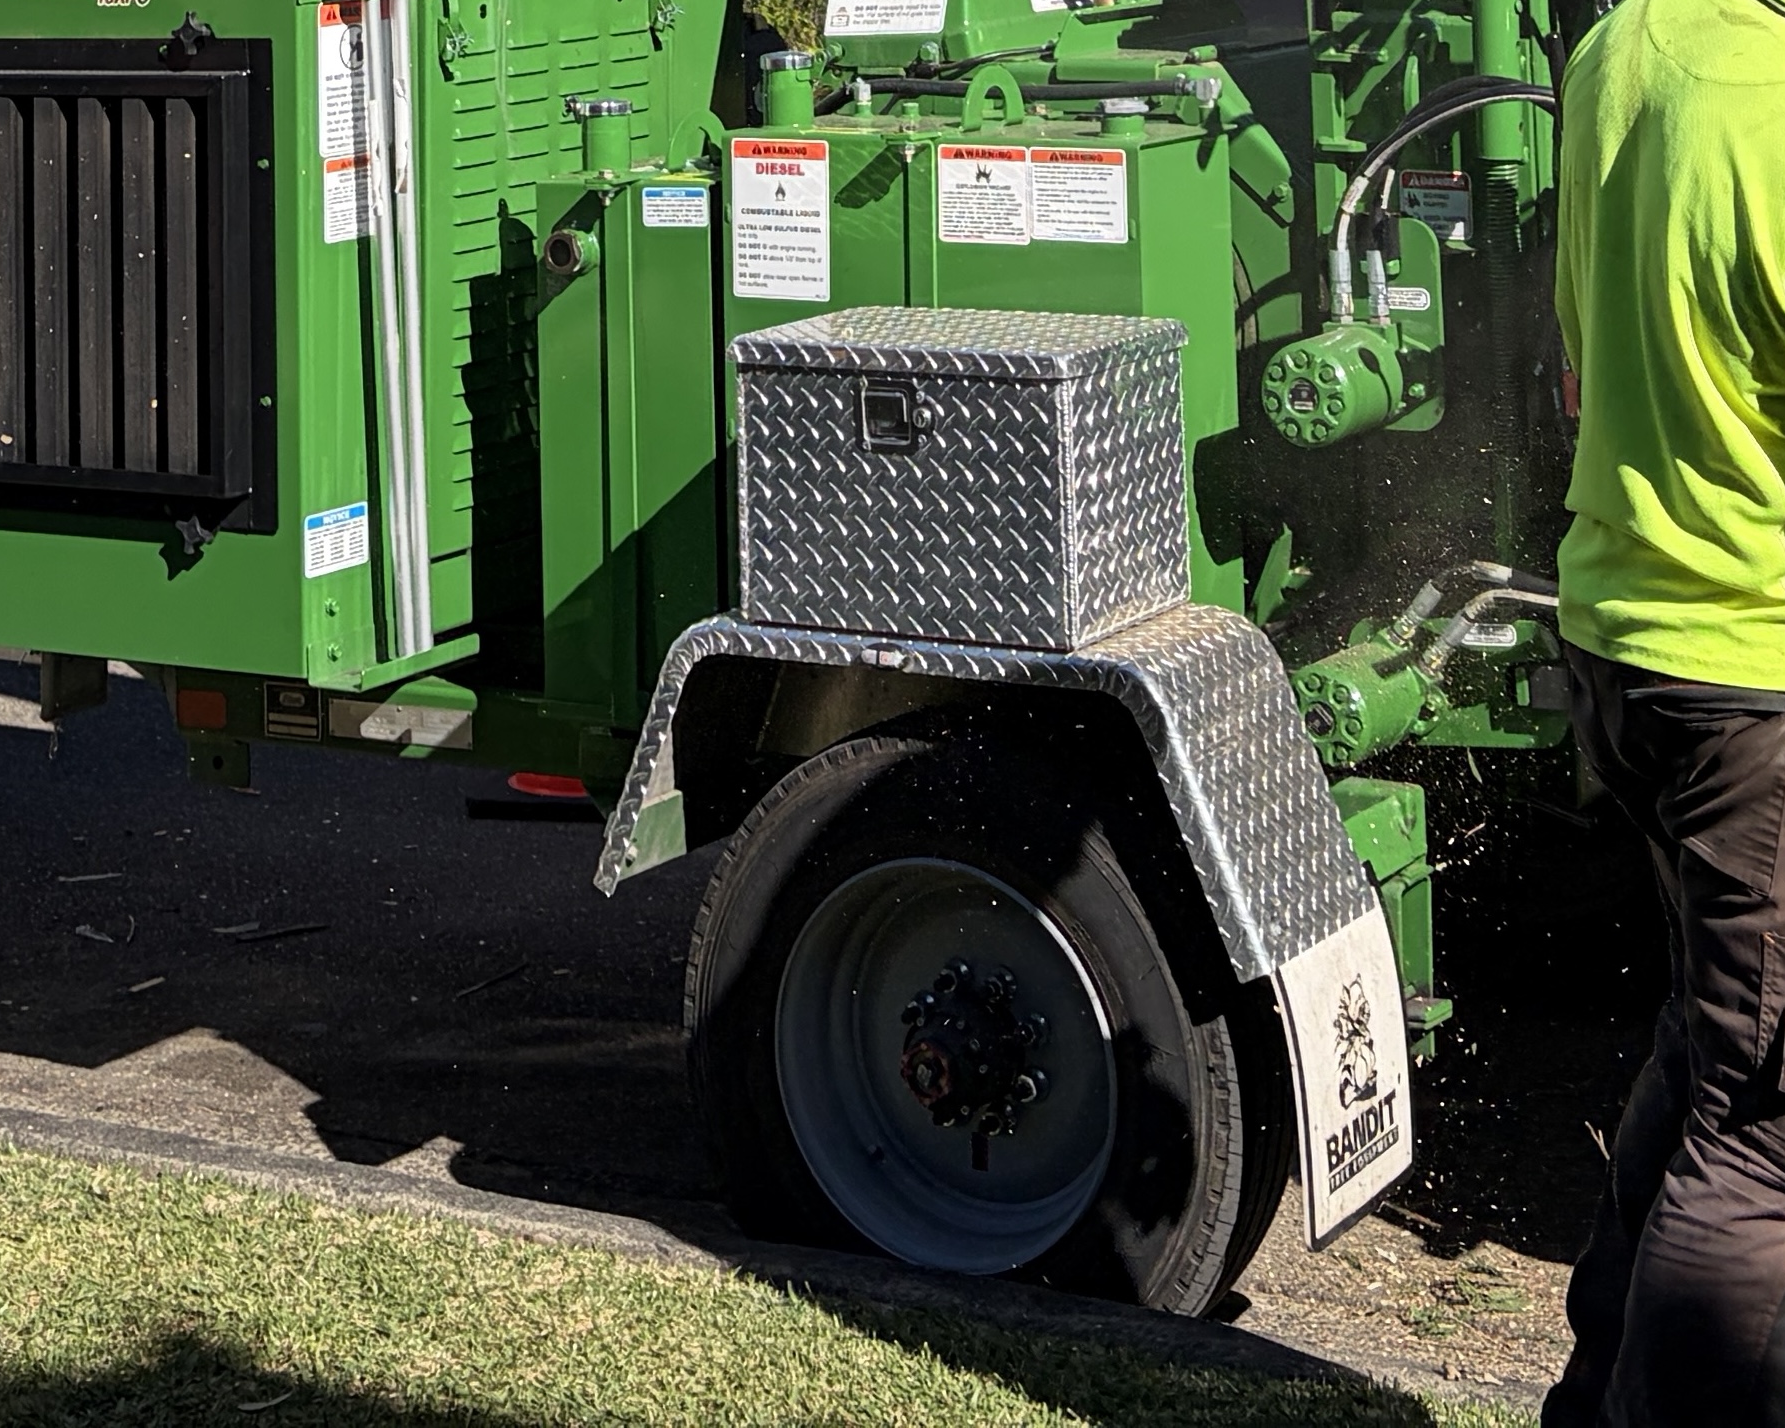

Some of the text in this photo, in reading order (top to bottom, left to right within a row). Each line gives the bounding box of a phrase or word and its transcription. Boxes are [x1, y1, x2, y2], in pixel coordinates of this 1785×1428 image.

[763, 145, 807, 155] WARNING
[964, 148, 1012, 160] WARNING
[1059, 152, 1103, 162] WARNING
[755, 162, 805, 176] DIESEL
[759, 224, 772, 232] LOW
[1326, 1088, 1396, 1176] BANDIT
